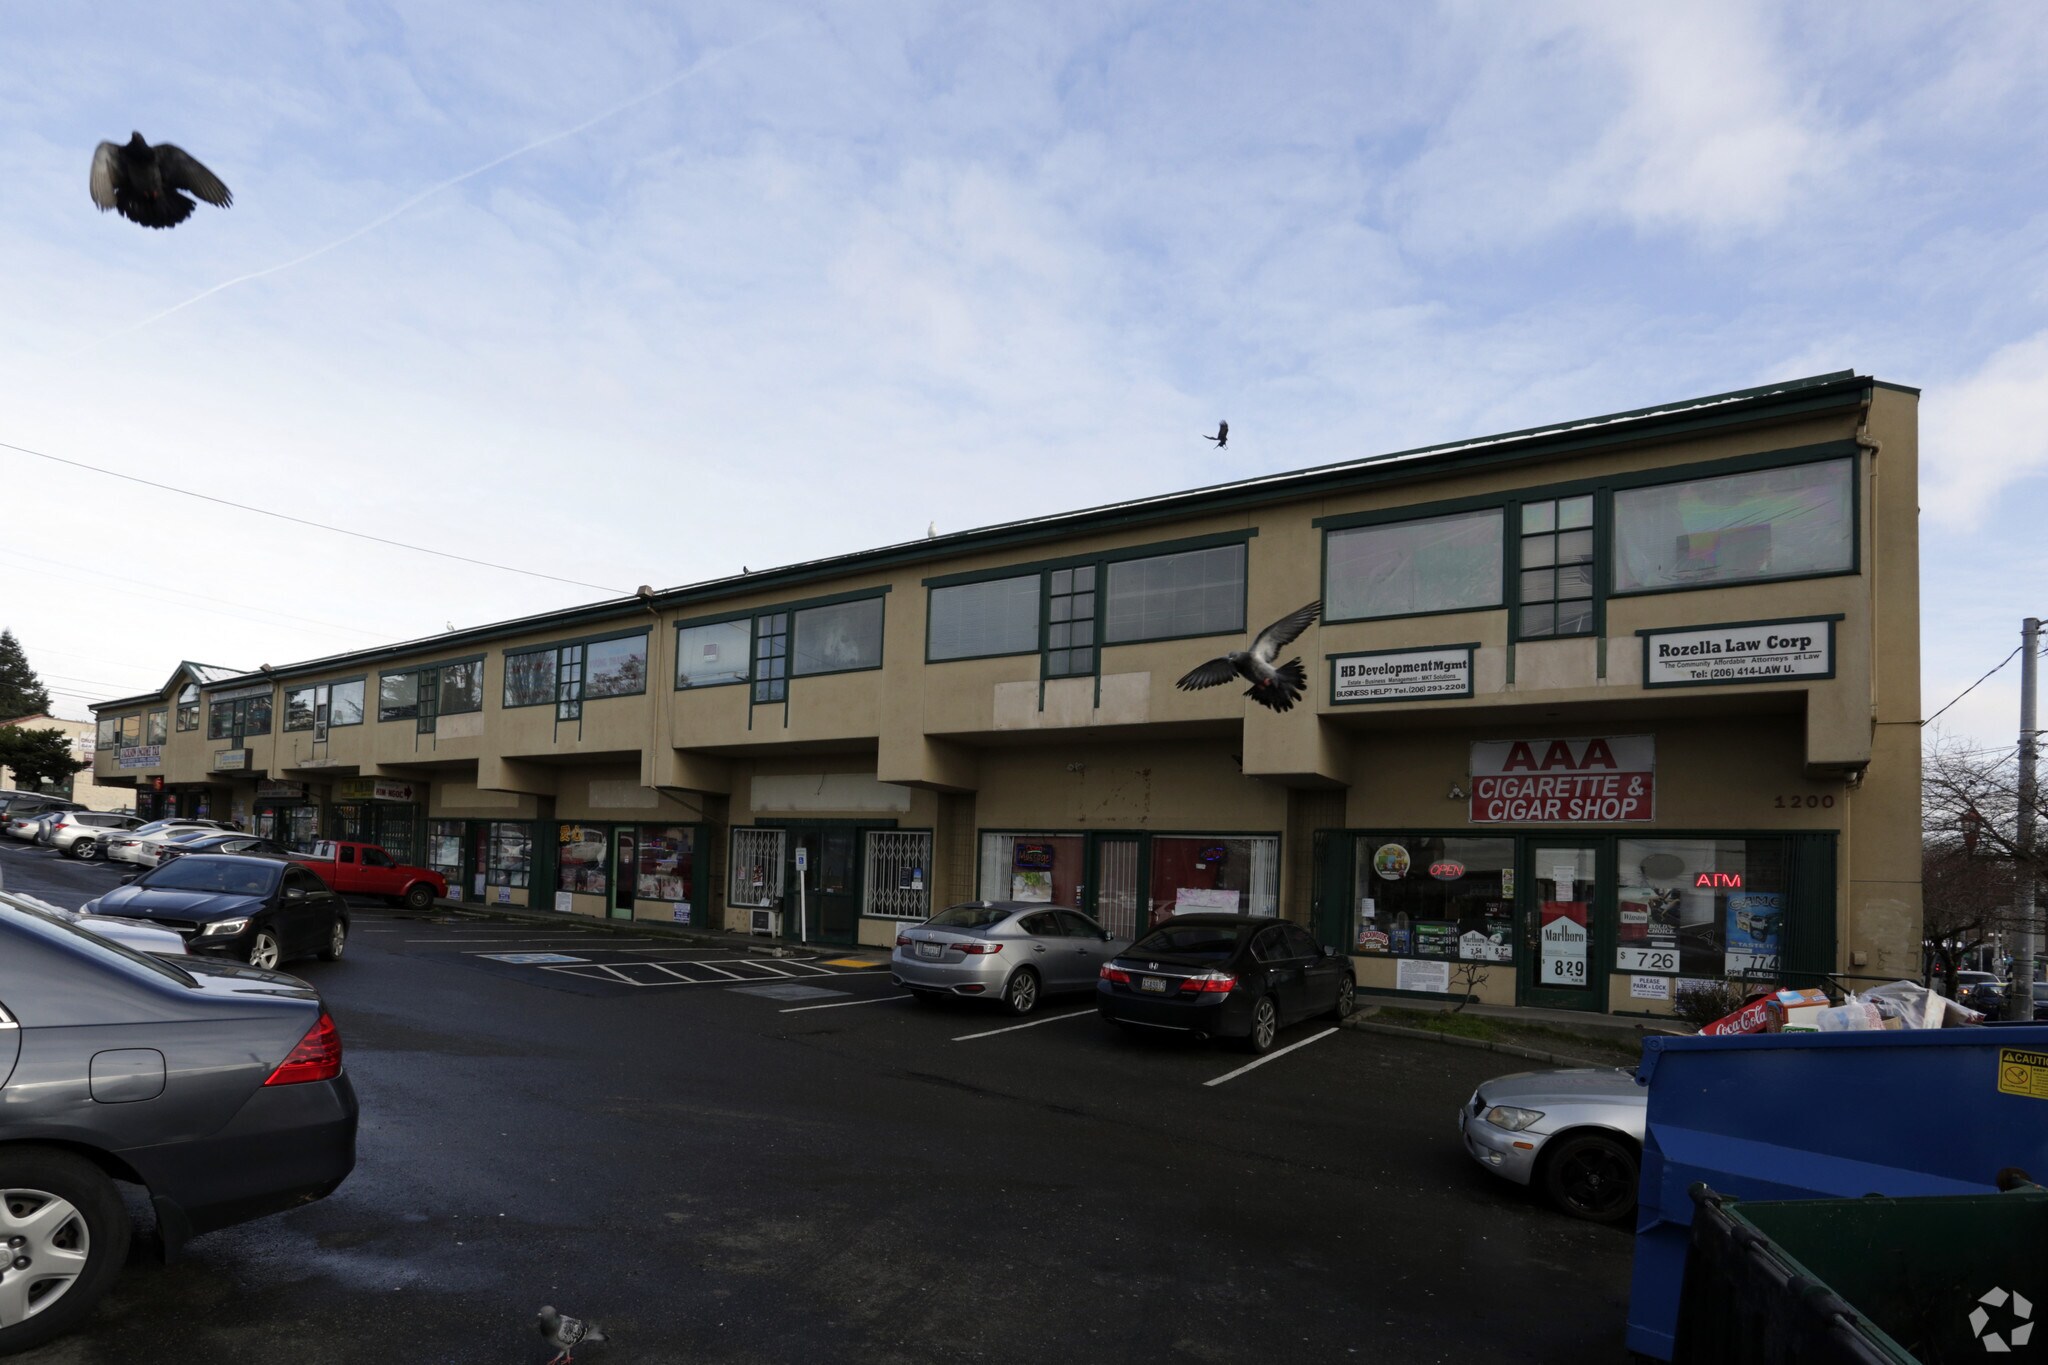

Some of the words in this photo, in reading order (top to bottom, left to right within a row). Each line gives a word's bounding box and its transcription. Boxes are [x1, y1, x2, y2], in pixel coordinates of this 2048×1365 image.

[1659, 641, 1722, 658] Rozella
[1725, 639, 1761, 652] Law
[1767, 635, 1812, 651] Corp
[1676, 660, 1711, 668] Community
[1713, 657, 1746, 666] Affordable
[1751, 655, 1789, 664] Attorneys
[1803, 652, 1820, 660] Law
[1340, 665, 1356, 678] HB
[1358, 660, 1432, 676] Development
[1433, 659, 1467, 672] Mgmt
[1691, 670, 1708, 679] Tel:
[1710, 668, 1735, 679] (206)
[1737, 664, 1780, 676] 414-LAW
[1388, 676, 1418, 684] Management
[1336, 688, 1369, 698] BUSINESS
[1371, 687, 1393, 696] HELP?
[1427, 683, 1467, 692] 293-2208
[1502, 738, 1618, 772] AAA
[1478, 776, 1621, 799] CIGARETTE
[1628, 775, 1645, 797] &
[1488, 799, 1562, 820] CIGAR
[1568, 798, 1638, 820] SHOP
[1774, 795, 1835, 809] 1200
[1430, 863, 1465, 877] OPEN
[1696, 873, 1742, 888] ATM
[1730, 895, 1785, 912] CAME
[1624, 912, 1647, 921] Winston
[1545, 925, 1584, 942] Marlboro
[1620, 951, 1626, 960] $
[1637, 952, 1674, 969] 7.26
[1639, 977, 1661, 985] PLEASE
[1727, 969, 1759, 978] SPEIAL
[2015, 1053, 2048, 1067] CAUTI
